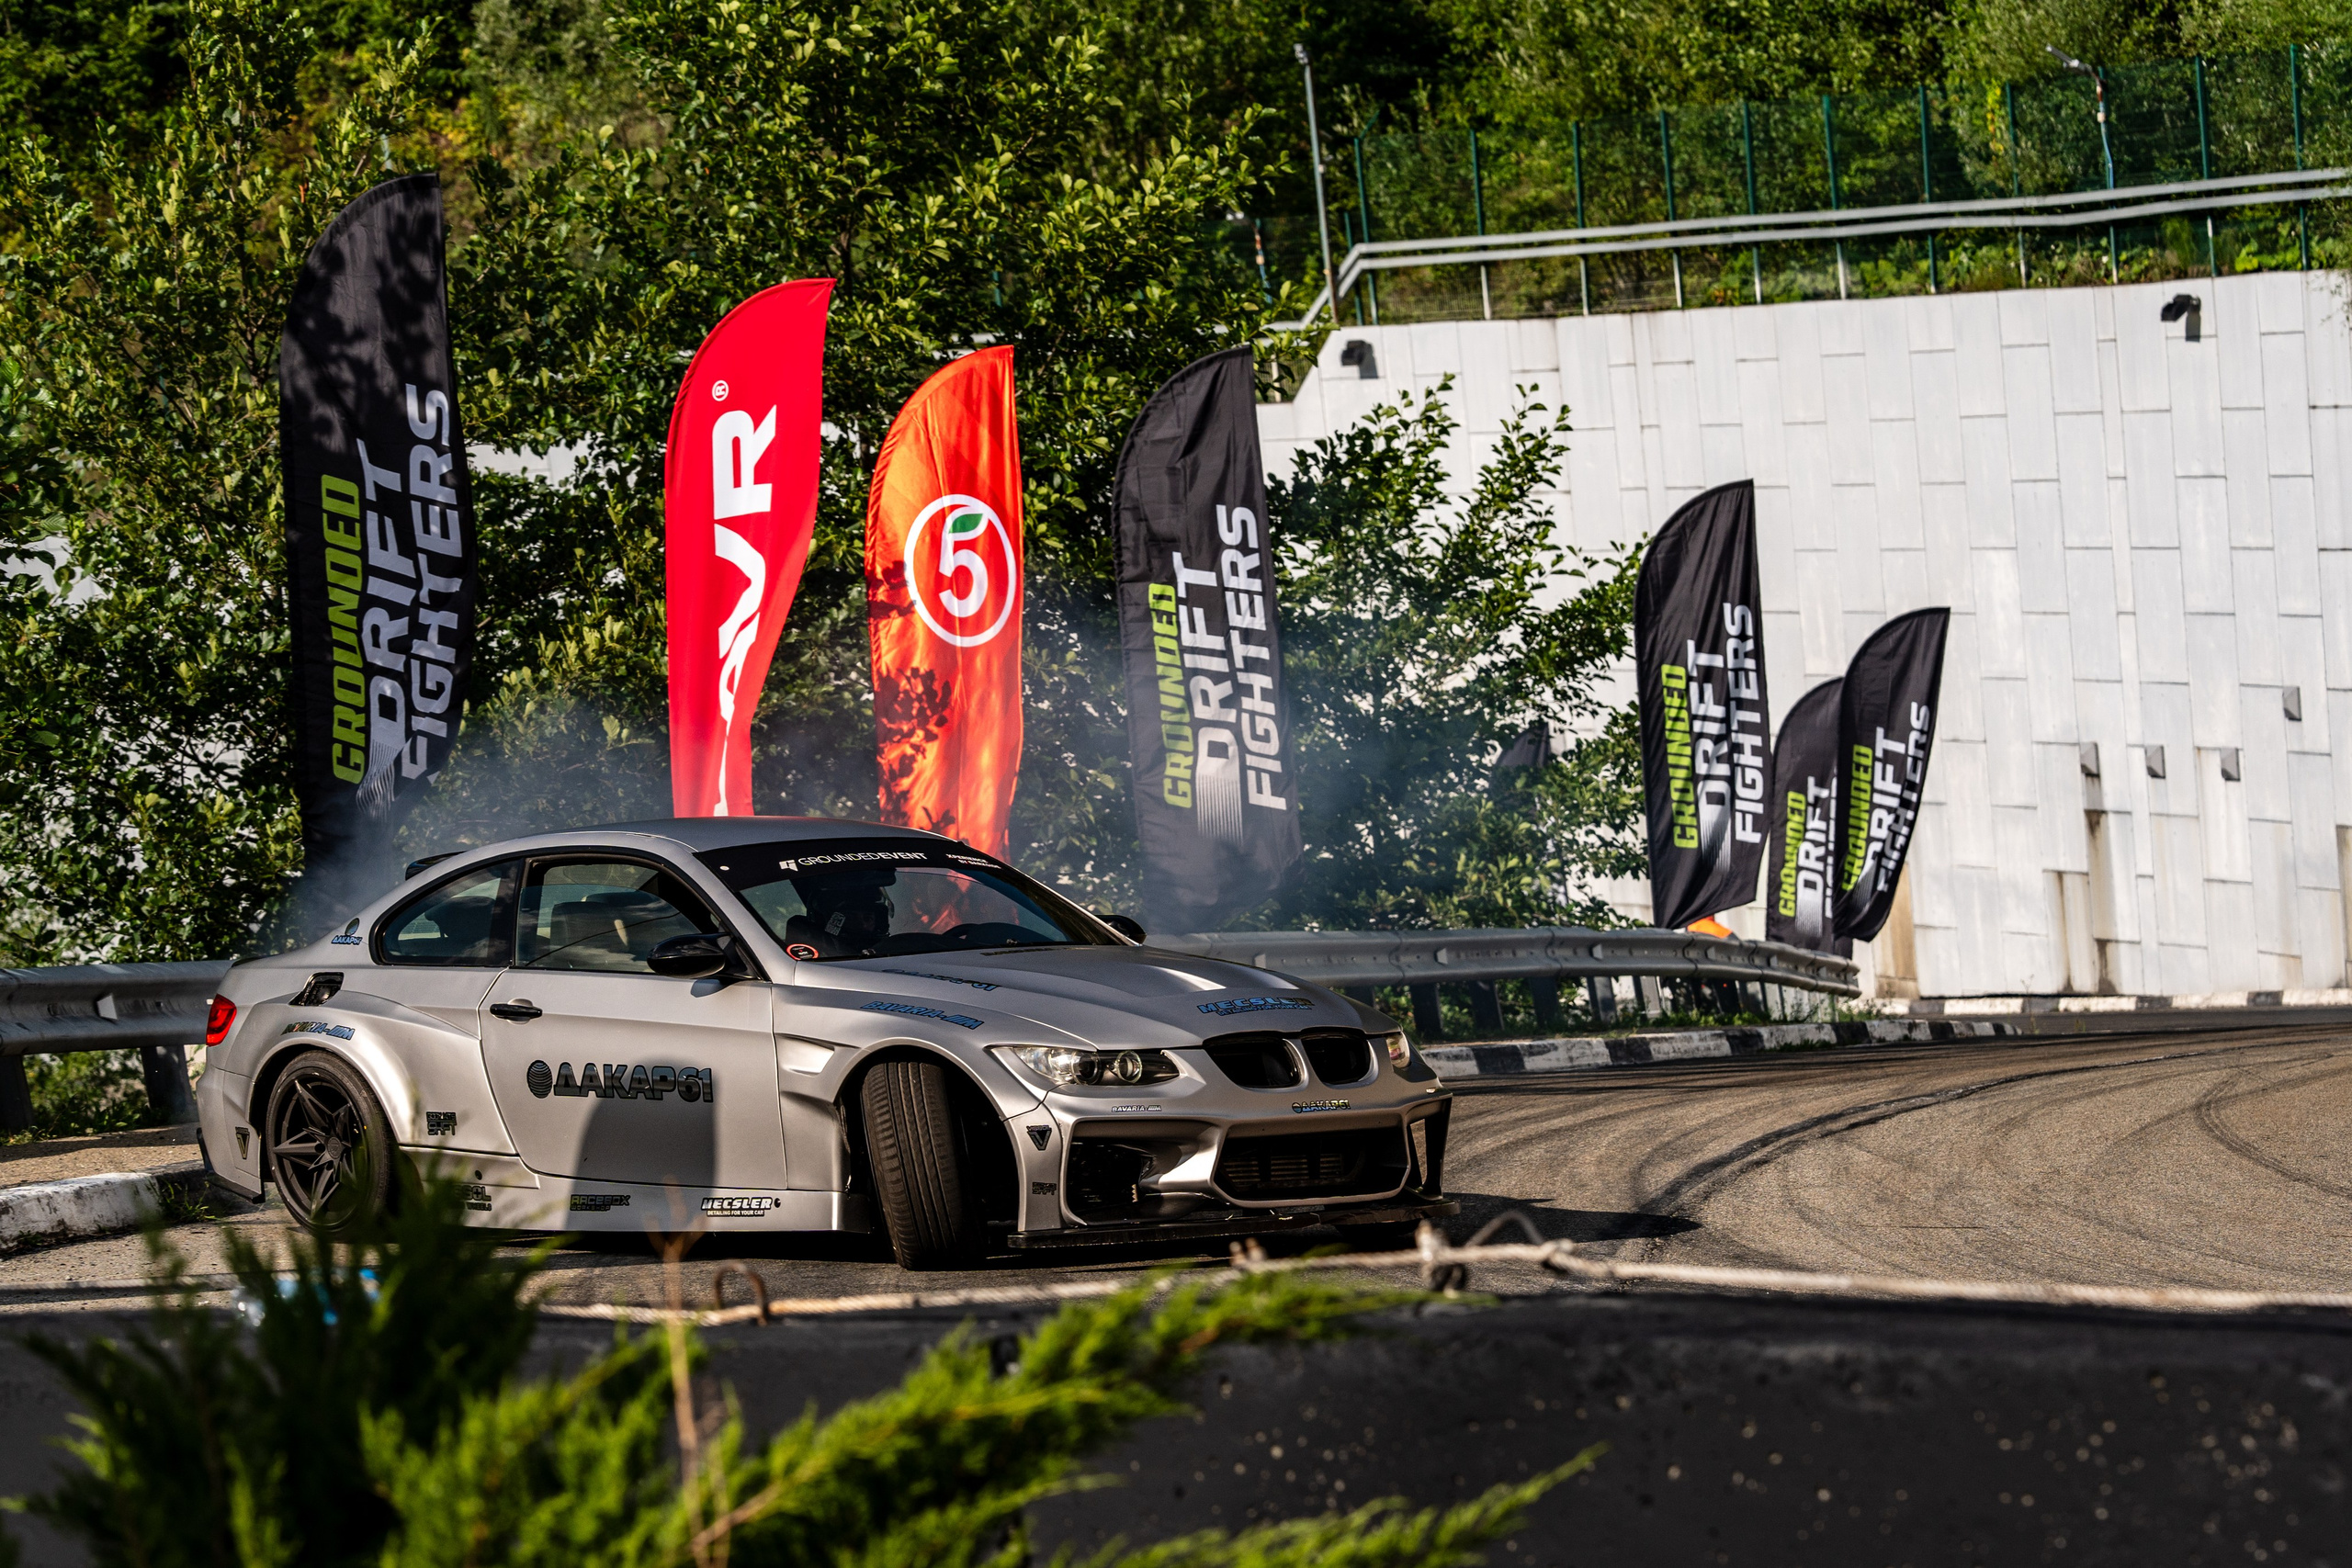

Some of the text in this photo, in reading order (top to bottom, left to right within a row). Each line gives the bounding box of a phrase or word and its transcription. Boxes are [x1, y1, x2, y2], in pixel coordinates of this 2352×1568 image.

[322, 474, 366, 784] GROUNDED
[356, 438, 416, 795] DRIFT
[401, 382, 462, 785] FIGHTERS
[1216, 503, 1287, 810] FIGHTERS
[1148, 582, 1193, 808] GROUNDED
[1172, 551, 1243, 827] DRIFT
[1661, 663, 1699, 849] GROUNDED
[1687, 638, 1732, 854] DRIFT
[1723, 602, 1764, 844] FIGHTERS
[1779, 791, 1806, 918] GROUNDED
[1794, 775, 1831, 923] DRIFT
[1841, 744, 1873, 891] GROUNDED
[553, 1062, 714, 1103] ДАКАР61
[1196, 997, 1315, 1014] MECSLER
[701, 1197, 774, 1211] MECSLER
[707, 1209, 731, 1217] DETAILING
[754, 1208, 764, 1216] CAR
